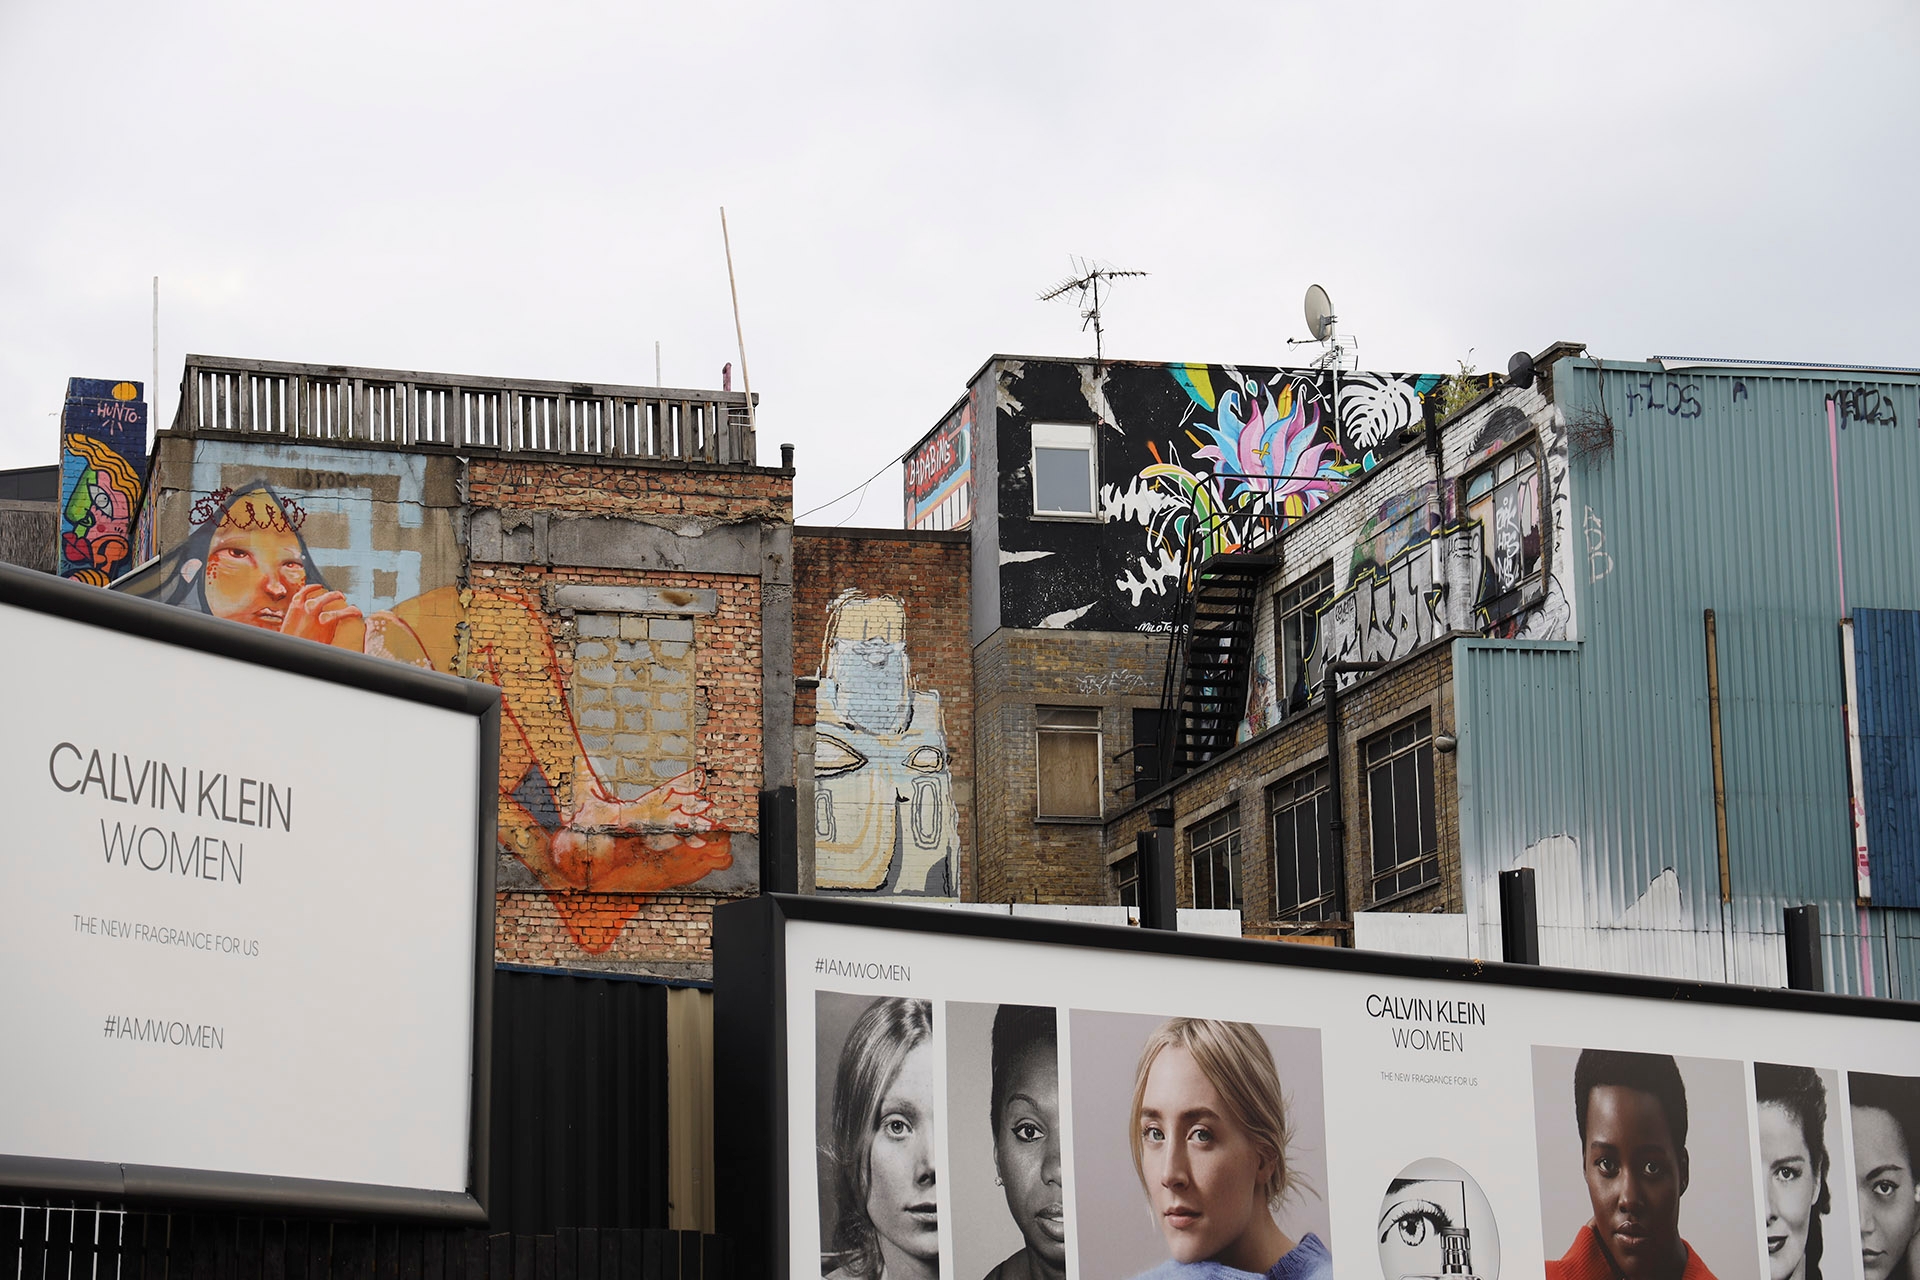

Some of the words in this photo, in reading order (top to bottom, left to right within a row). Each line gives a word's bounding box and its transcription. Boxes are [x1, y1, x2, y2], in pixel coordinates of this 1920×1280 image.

[97, 402, 138, 424] HUNTO
[49, 742, 187, 814] CALVIN
[197, 769, 292, 833] KLEIN
[101, 818, 243, 885] WOMEN
[73, 914, 98, 935] THE
[100, 918, 132, 939] NEW
[134, 923, 212, 951] FRAGRANCE
[215, 935, 240, 955] FOR
[243, 939, 260, 957] US
[815, 957, 911, 982] #IAMWOMEN
[1366, 993, 1433, 1023] CALVIN
[1437, 999, 1486, 1026] KLEIN
[103, 1014, 224, 1050] #IAMWOMEN
[1392, 1026, 1464, 1053] WOMEN
[1380, 1071, 1394, 1082] THE
[1395, 1072, 1411, 1083] NEW
[1411, 1073, 1453, 1086] FRAGRANCE
[1453, 1076, 1468, 1086] FOR
[1468, 1077, 1479, 1087] US
